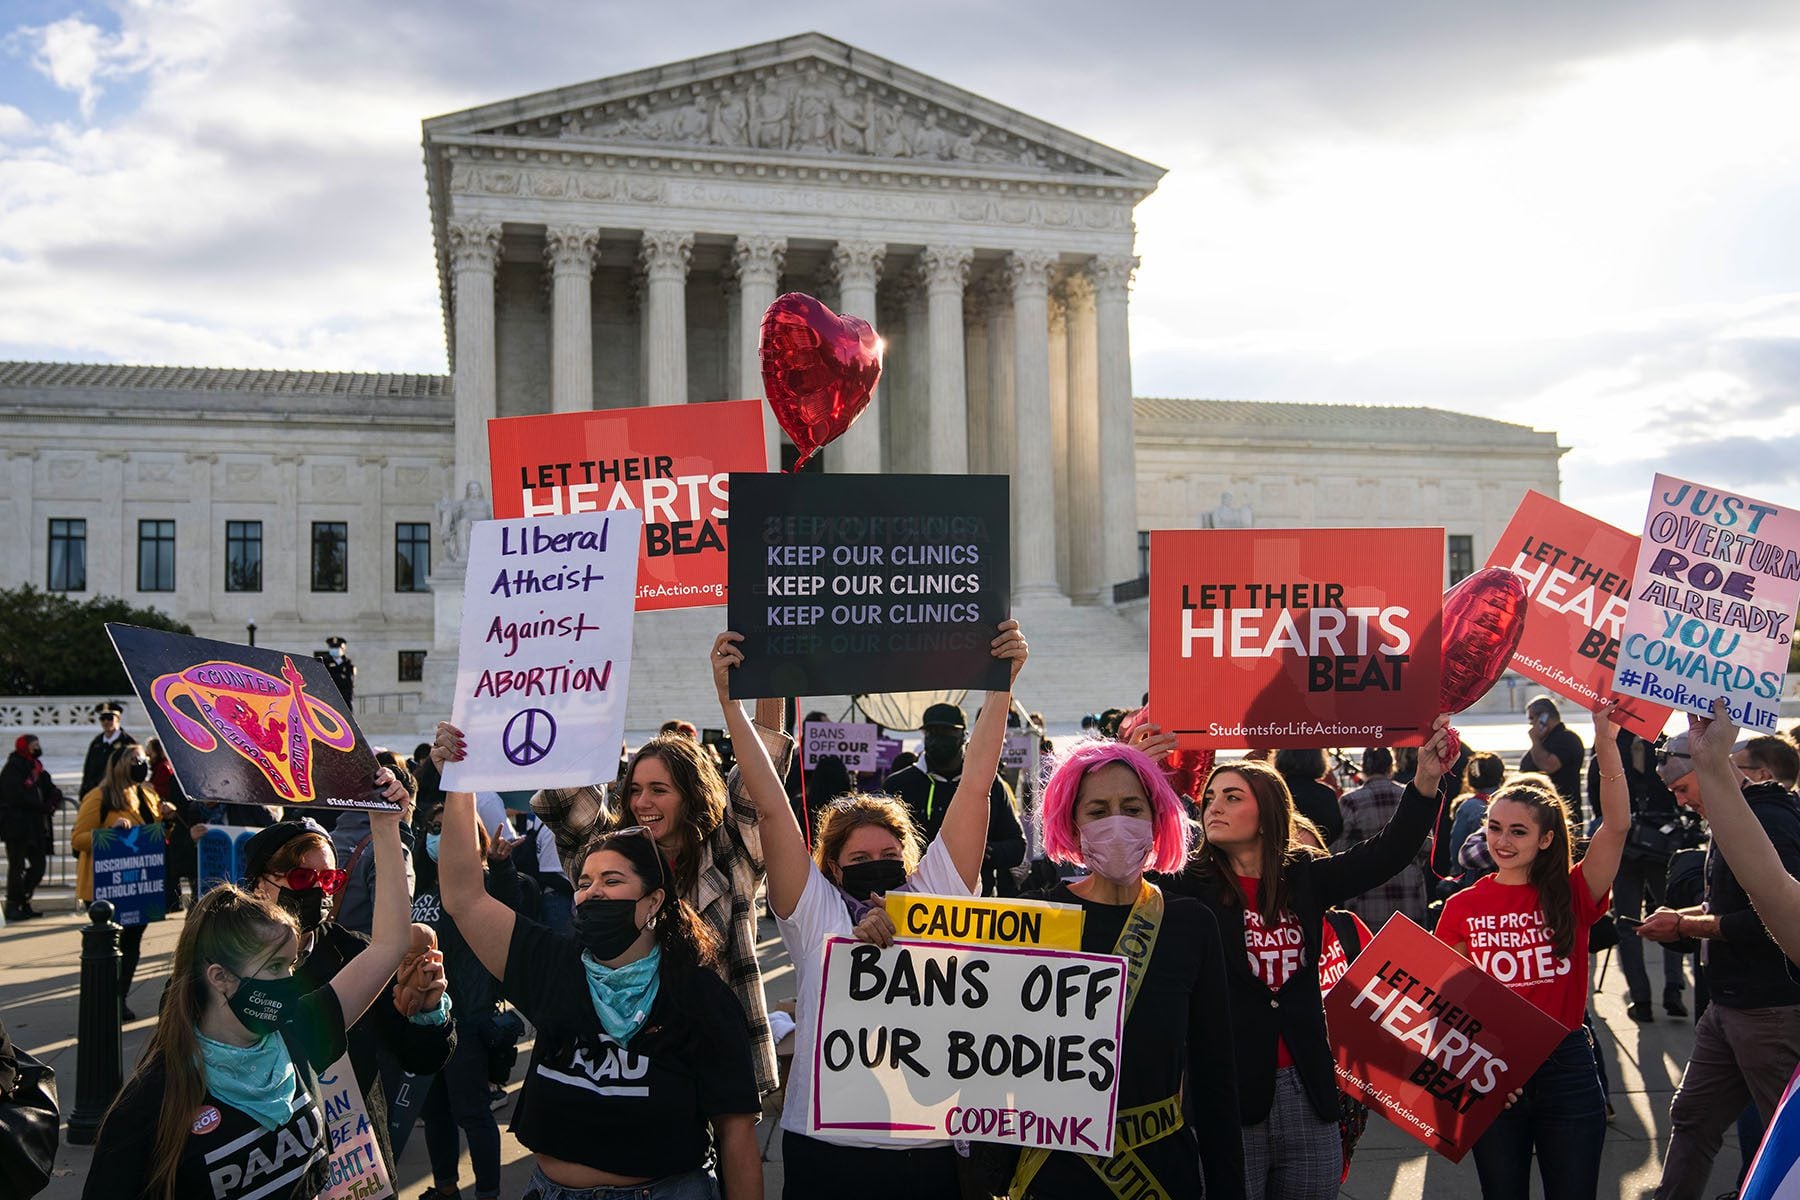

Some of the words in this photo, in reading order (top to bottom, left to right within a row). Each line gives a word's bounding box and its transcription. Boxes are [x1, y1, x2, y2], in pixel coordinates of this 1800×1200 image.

[681, 185, 745, 204] EQUAL
[751, 189, 823, 209] JUSTICE
[835, 193, 900, 212] UNDER
[903, 197, 938, 215] LAW
[521, 463, 572, 489] LET
[580, 456, 674, 484] THEIR
[522, 472, 729, 525] HEARTS
[1663, 484, 1778, 534] JUST
[767, 546, 825, 566] KEEP
[832, 546, 884, 565] OUR
[891, 545, 980, 565] CLINICS
[1650, 511, 1800, 582] OVERTURN
[490, 564, 604, 598] Atheist
[767, 576, 825, 596] KEEP
[832, 575, 883, 595] OUR
[890, 574, 980, 594] CLINICS
[1521, 536, 1567, 567] LET
[1569, 556, 1632, 601] THEI
[1649, 548, 1756, 600] ROE
[635, 583, 723, 600] ifeAction.org
[1182, 584, 1237, 610] LET
[1245, 583, 1345, 609] THEIR
[767, 606, 824, 626] KEEP
[831, 605, 882, 625] OUR
[889, 603, 980, 624] CLINICS
[1639, 581, 1790, 645] ALREADY,
[486, 610, 600, 657] Against
[1181, 606, 1411, 658] HEARTS
[1663, 610, 1741, 658] YOU
[198, 669, 280, 694] COUNTER
[1308, 655, 1410, 693] BEAT
[1625, 633, 1786, 702] COWARDS!
[809, 727, 845, 739] BANS
[809, 741, 836, 751] OFF
[838, 741, 869, 753] OUR
[1209, 721, 1383, 739] StudentsforLifeAction.org
[290, 713, 309, 794] VIOLENCE
[95, 853, 164, 874] DISCRIMINATION
[112, 872, 122, 884] IS
[123, 870, 140, 883] NOT
[140, 869, 148, 880] A
[95, 883, 138, 900] CATHOLIC
[138, 879, 164, 896] VALUE
[907, 903, 1041, 943] CAUTION
[1466, 915, 1496, 932] THE
[1471, 945, 1571, 982] VOTES
[849, 945, 990, 1009] BANS
[1021, 963, 1120, 1020] OFF
[1376, 960, 1420, 995] LET
[1418, 986, 1483, 1040] THEIR
[243, 1007, 278, 1021] COVERED
[249, 995, 282, 1009] COVERED
[1350, 975, 1509, 1095] HEARTS
[824, 1025, 930, 1078] OUR
[947, 1031, 1116, 1092] BODIES
[1409, 1058, 1486, 1115] BEAT
[193, 1111, 219, 1131] ROE
[331, 1121, 352, 1149] BE
[356, 1113, 370, 1135] A
[945, 1105, 1099, 1152] CODEPINK
[209, 1106, 323, 1199] PAAU
